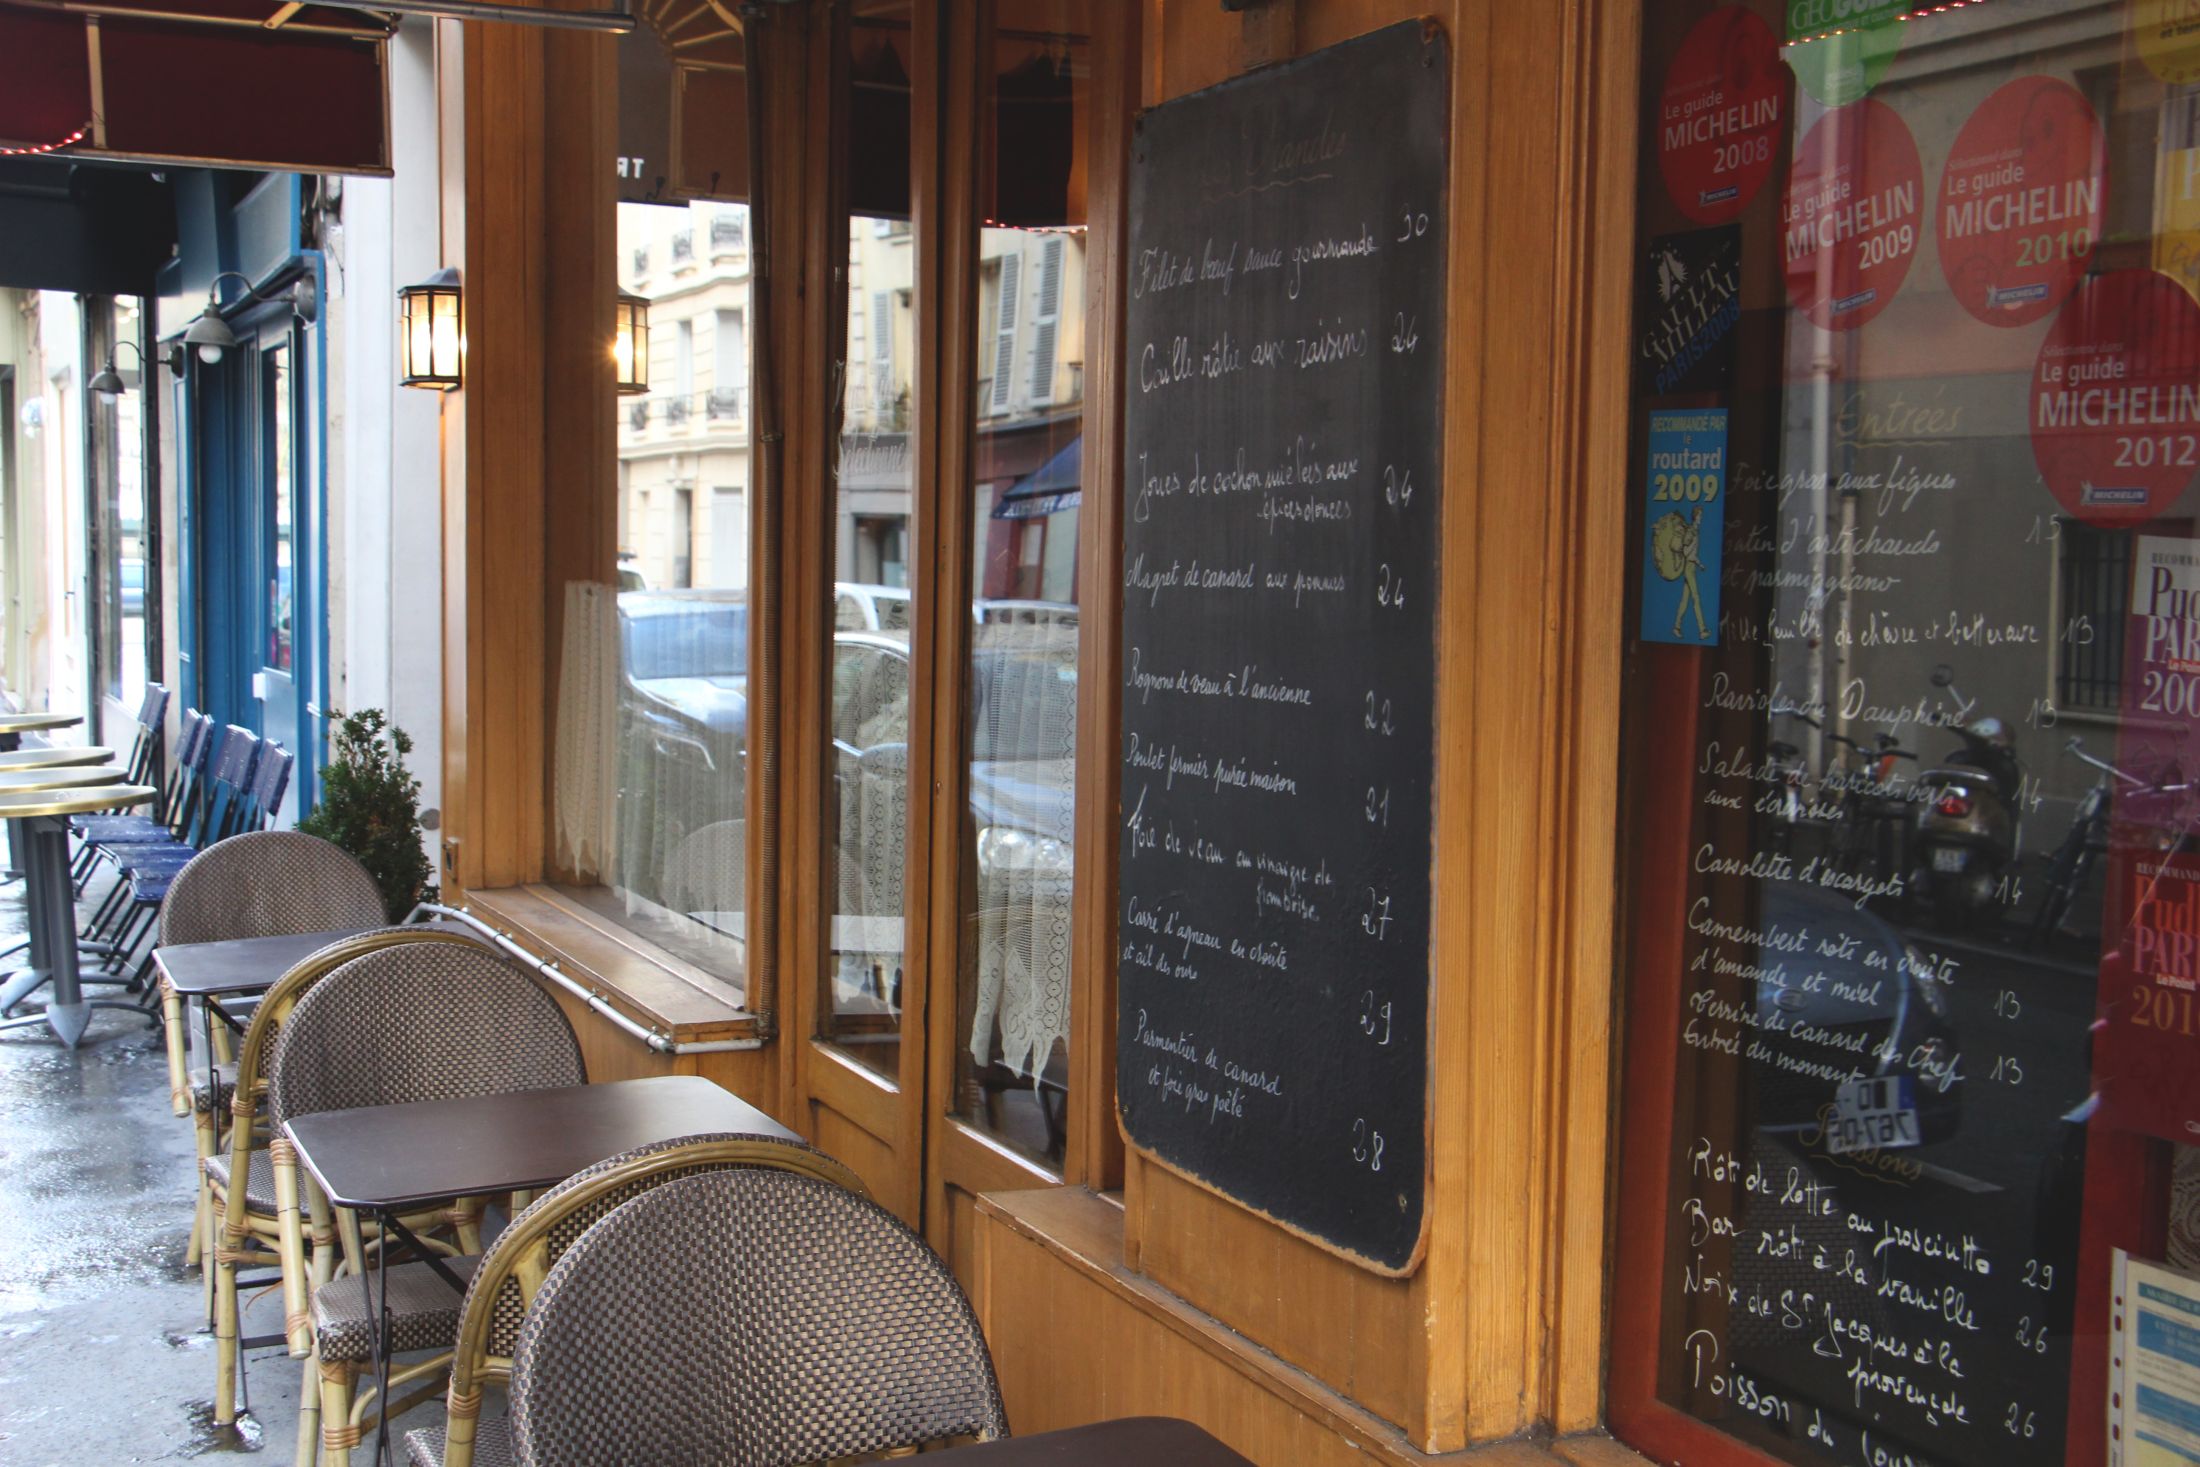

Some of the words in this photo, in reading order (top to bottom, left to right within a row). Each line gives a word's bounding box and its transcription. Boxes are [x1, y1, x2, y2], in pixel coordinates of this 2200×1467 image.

[1664, 95, 1779, 151] MICHELIN
[1665, 104, 1681, 120] Le
[1684, 90, 1724, 116] guide
[1712, 135, 1769, 174] 2008
[1948, 174, 1967, 195] Le
[1972, 161, 2025, 195] guide
[1783, 203, 1800, 223] Le
[1806, 180, 1850, 218] guide
[1784, 180, 1914, 263] MICHELIN
[1946, 177, 2097, 239] MICHELIN
[1135, 247, 1177, 299] Filet
[1179, 256, 1194, 283] de
[1858, 224, 1913, 270] 2009
[2015, 227, 2092, 268] 2010
[1140, 336, 1194, 392] Caille
[1251, 338, 1285, 368] aux
[1295, 317, 1368, 368] raisins
[1392, 311, 1418, 354] 24
[2041, 362, 2061, 382] Le
[2068, 356, 2124, 387] guide
[1836, 386, 1962, 437] Entrées
[2038, 384, 2200, 427] MICHELIN
[1652, 448, 1721, 470] routard
[2114, 436, 2196, 467] 2012
[1134, 452, 1180, 523] Joues
[1189, 452, 1208, 497] de
[1213, 448, 1262, 494] cochon
[1326, 458, 1359, 481] aux
[1384, 464, 1413, 507] 24
[1653, 474, 1718, 502] 2009
[1778, 470, 1827, 511] gras
[1836, 472, 1882, 491] aux
[1878, 455, 1956, 517] figues
[1126, 552, 1179, 609] Magret
[1184, 560, 1201, 587] de
[1202, 563, 1254, 588] canard
[1266, 572, 1288, 589] aux
[1294, 569, 1345, 609] pommes
[1377, 563, 1405, 610] 24
[1834, 610, 1853, 647] de
[1924, 619, 1940, 640] et
[1126, 647, 1174, 704] Rognons
[1176, 670, 1189, 693] de
[1190, 674, 1221, 696] veau
[1224, 673, 1236, 697] à
[1239, 664, 1312, 705] l'ancienne
[1364, 689, 1395, 736] 22
[1840, 677, 1976, 737] Dauphiné
[1126, 732, 1165, 771] Poulet
[1167, 745, 1208, 791] fermier
[1213, 757, 1247, 793] purée
[1249, 760, 1297, 795] maison
[1700, 741, 1779, 782] Salade
[1784, 762, 1810, 788] de
[1365, 786, 1390, 827] 21
[1127, 783, 1156, 858] Foie
[1165, 820, 1181, 853] de
[1188, 838, 1225, 864] veau
[1314, 858, 1334, 886] de
[1695, 843, 1794, 880] Cassolette
[1799, 854, 1904, 909] d'escargots
[1995, 876, 2023, 905] 14
[1127, 895, 1162, 933] Carré
[1164, 908, 1222, 957] d'agneau
[1231, 939, 1246, 957] en
[1249, 941, 1288, 971] croûte
[1361, 886, 1393, 940] 27
[1156, 954, 1171, 974] des
[1175, 965, 1198, 980] ours
[1688, 897, 1809, 953] Camembert
[1817, 933, 1861, 960] rôti
[1865, 952, 1888, 971] en
[1897, 954, 1961, 985] croûte
[1691, 948, 1789, 988] d'amande
[1802, 973, 1822, 993] et
[1831, 979, 1880, 1007] miel
[1360, 990, 1392, 1045] 29
[1994, 989, 2021, 1019] 13
[1134, 1007, 1198, 1063] Parmentier
[1205, 1047, 1219, 1070] de
[1224, 1060, 1282, 1096] canard
[1684, 1018, 1740, 1055] Entrée
[1746, 1042, 1771, 1061] du
[1776, 1050, 1866, 1085] moment
[1690, 989, 1760, 1028] Terrine
[1765, 1009, 1786, 1031] de
[1908, 1046, 1965, 1093] Chef
[1148, 1063, 1161, 1086] et
[1162, 1065, 1183, 1102] foie
[1185, 1083, 1208, 1113] gras
[1211, 1089, 1243, 1124] poêlé
[1990, 1055, 2023, 1085] 13
[1352, 1117, 1384, 1171] 28
[1687, 1137, 1741, 1183] Rôti
[1745, 1164, 1774, 1195] de
[1780, 1167, 1839, 1217] lotte
[1847, 1213, 1874, 1233] au
[1873, 1220, 1991, 1283] prosciutto
[1682, 1198, 1746, 1246] Bar
[1757, 1226, 1804, 1260] rôti
[1813, 1244, 1831, 1270] à
[1836, 1250, 1868, 1286] la
[1878, 1280, 1980, 1331] vanille
[2022, 1259, 2054, 1290] 29
[1683, 1254, 1738, 1305] Noix
[1748, 1283, 1773, 1317] de
[1813, 1302, 1908, 1366] Jacques
[1914, 1341, 1934, 1365] à
[1938, 1341, 1965, 1378] la
[2015, 1316, 2048, 1354] 26
[1685, 1329, 1791, 1422] Poisson
[1807, 1409, 1834, 1446] du
[2004, 1402, 2035, 1437] 26
